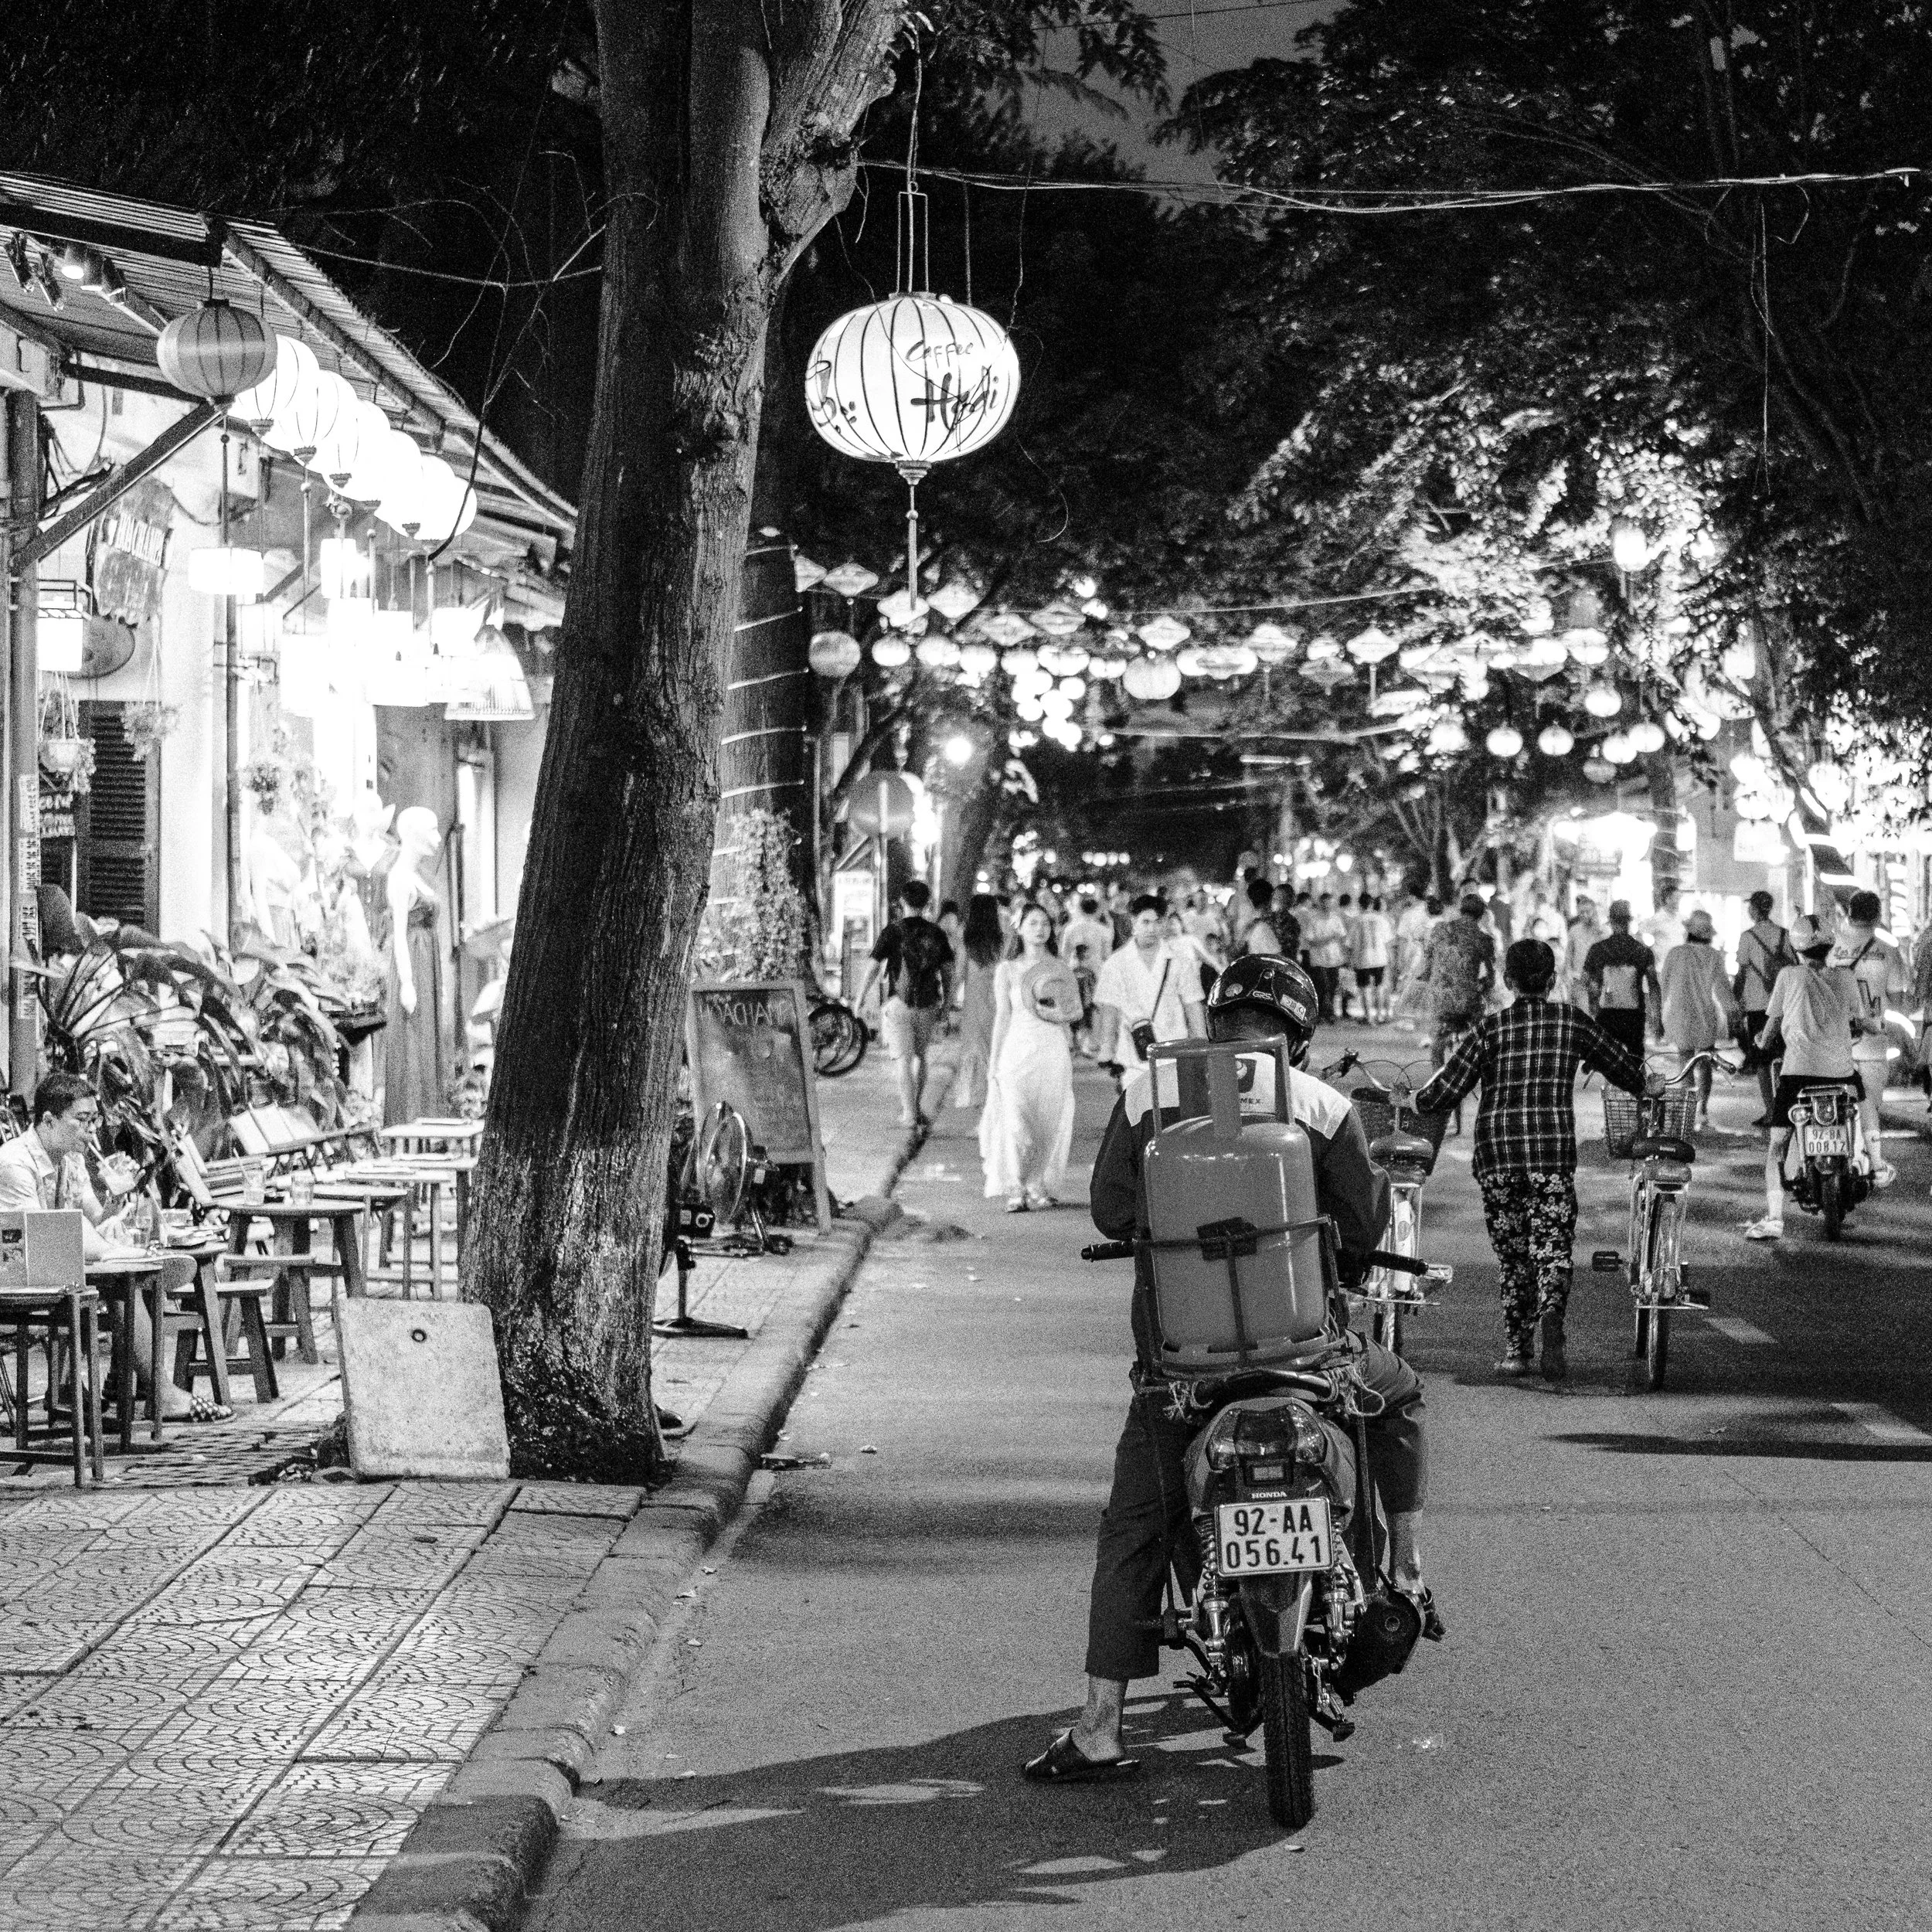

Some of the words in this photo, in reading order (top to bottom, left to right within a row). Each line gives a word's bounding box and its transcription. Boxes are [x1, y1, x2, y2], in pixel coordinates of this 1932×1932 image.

[1253, 991, 1273, 1001] GRS
[1251, 1491, 1288, 1499] HONDA
[1234, 1505, 1313, 1536] 92-AA
[1226, 1536, 1321, 1569] 056.41
